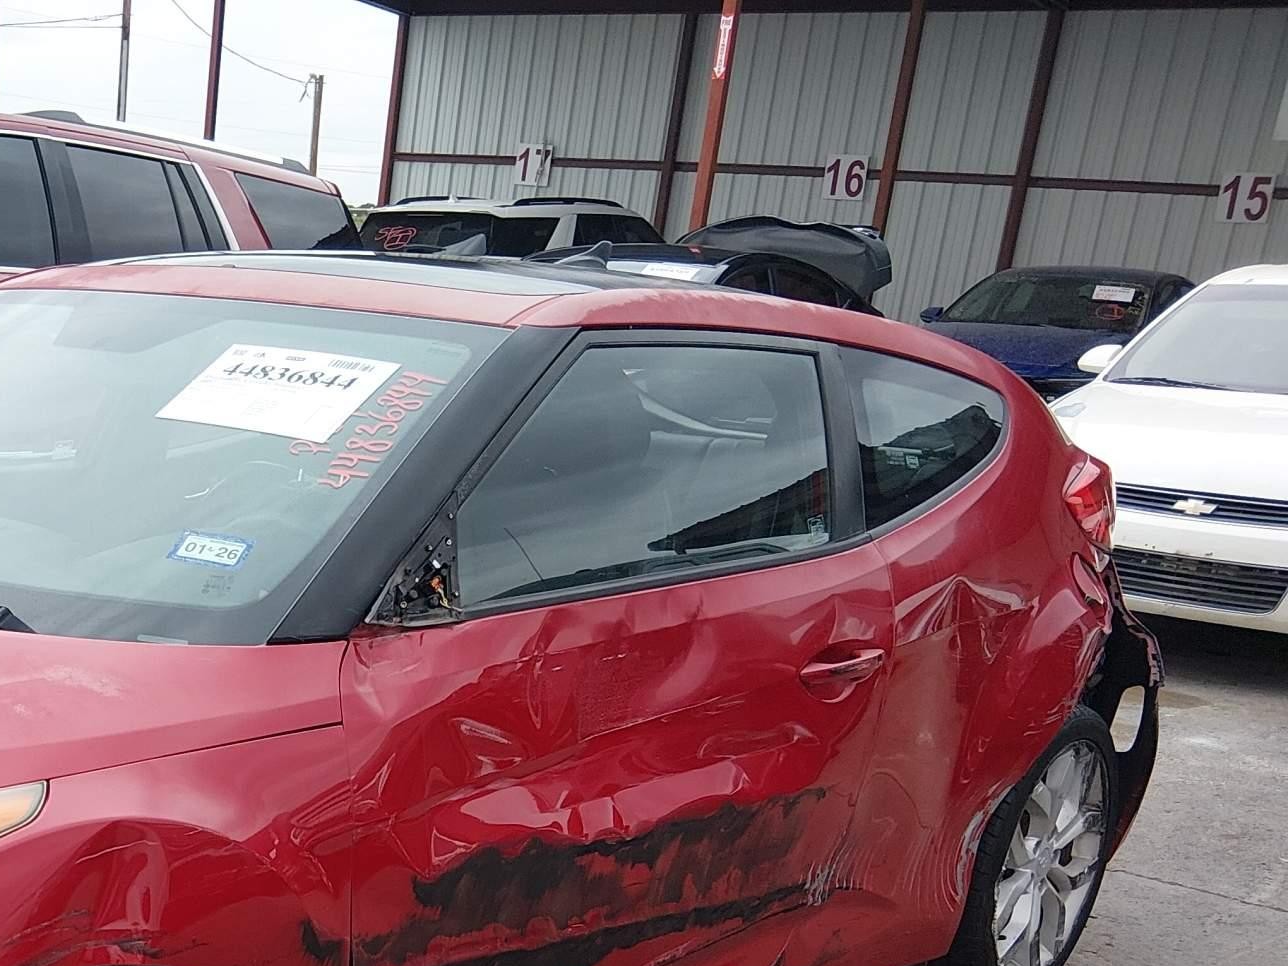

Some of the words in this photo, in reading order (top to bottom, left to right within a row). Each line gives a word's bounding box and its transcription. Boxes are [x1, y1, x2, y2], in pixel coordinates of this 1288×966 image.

[518, 147, 551, 182] 17
[827, 158, 865, 197] 16
[1223, 175, 1272, 221] 15
[223, 362, 360, 391] 44836844
[318, 371, 450, 489] 44836844
